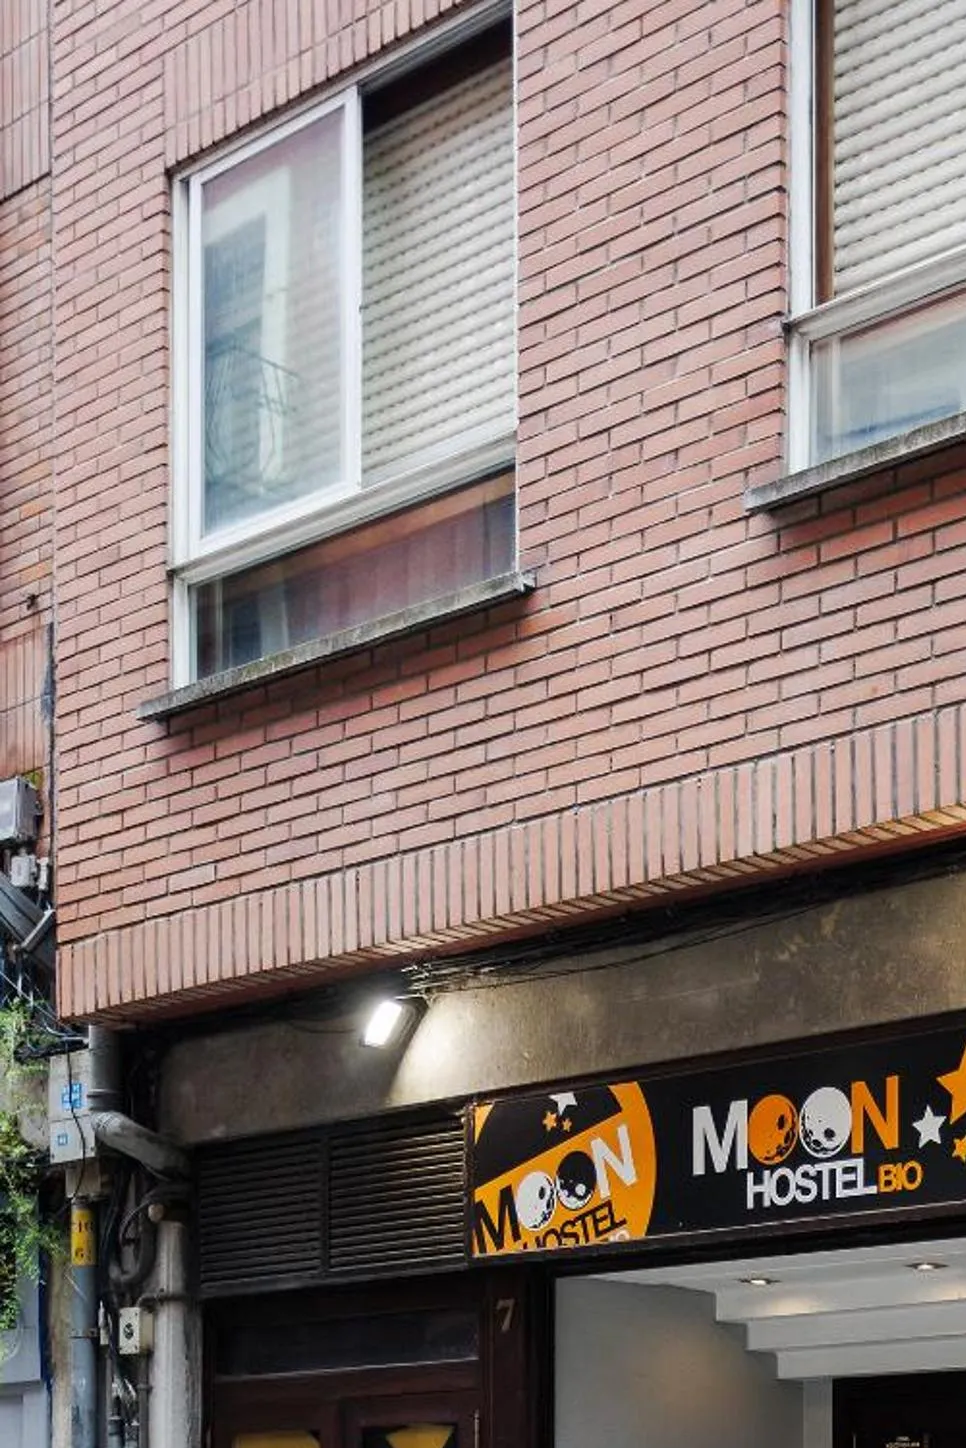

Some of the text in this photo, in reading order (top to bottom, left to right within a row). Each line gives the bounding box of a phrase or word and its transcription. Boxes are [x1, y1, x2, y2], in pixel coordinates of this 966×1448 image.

[693, 1076, 899, 1176] MOON
[472, 1124, 637, 1254] MOON
[747, 1158, 923, 1210] HOSTEL BIO
[496, 1298, 515, 1332] 7
